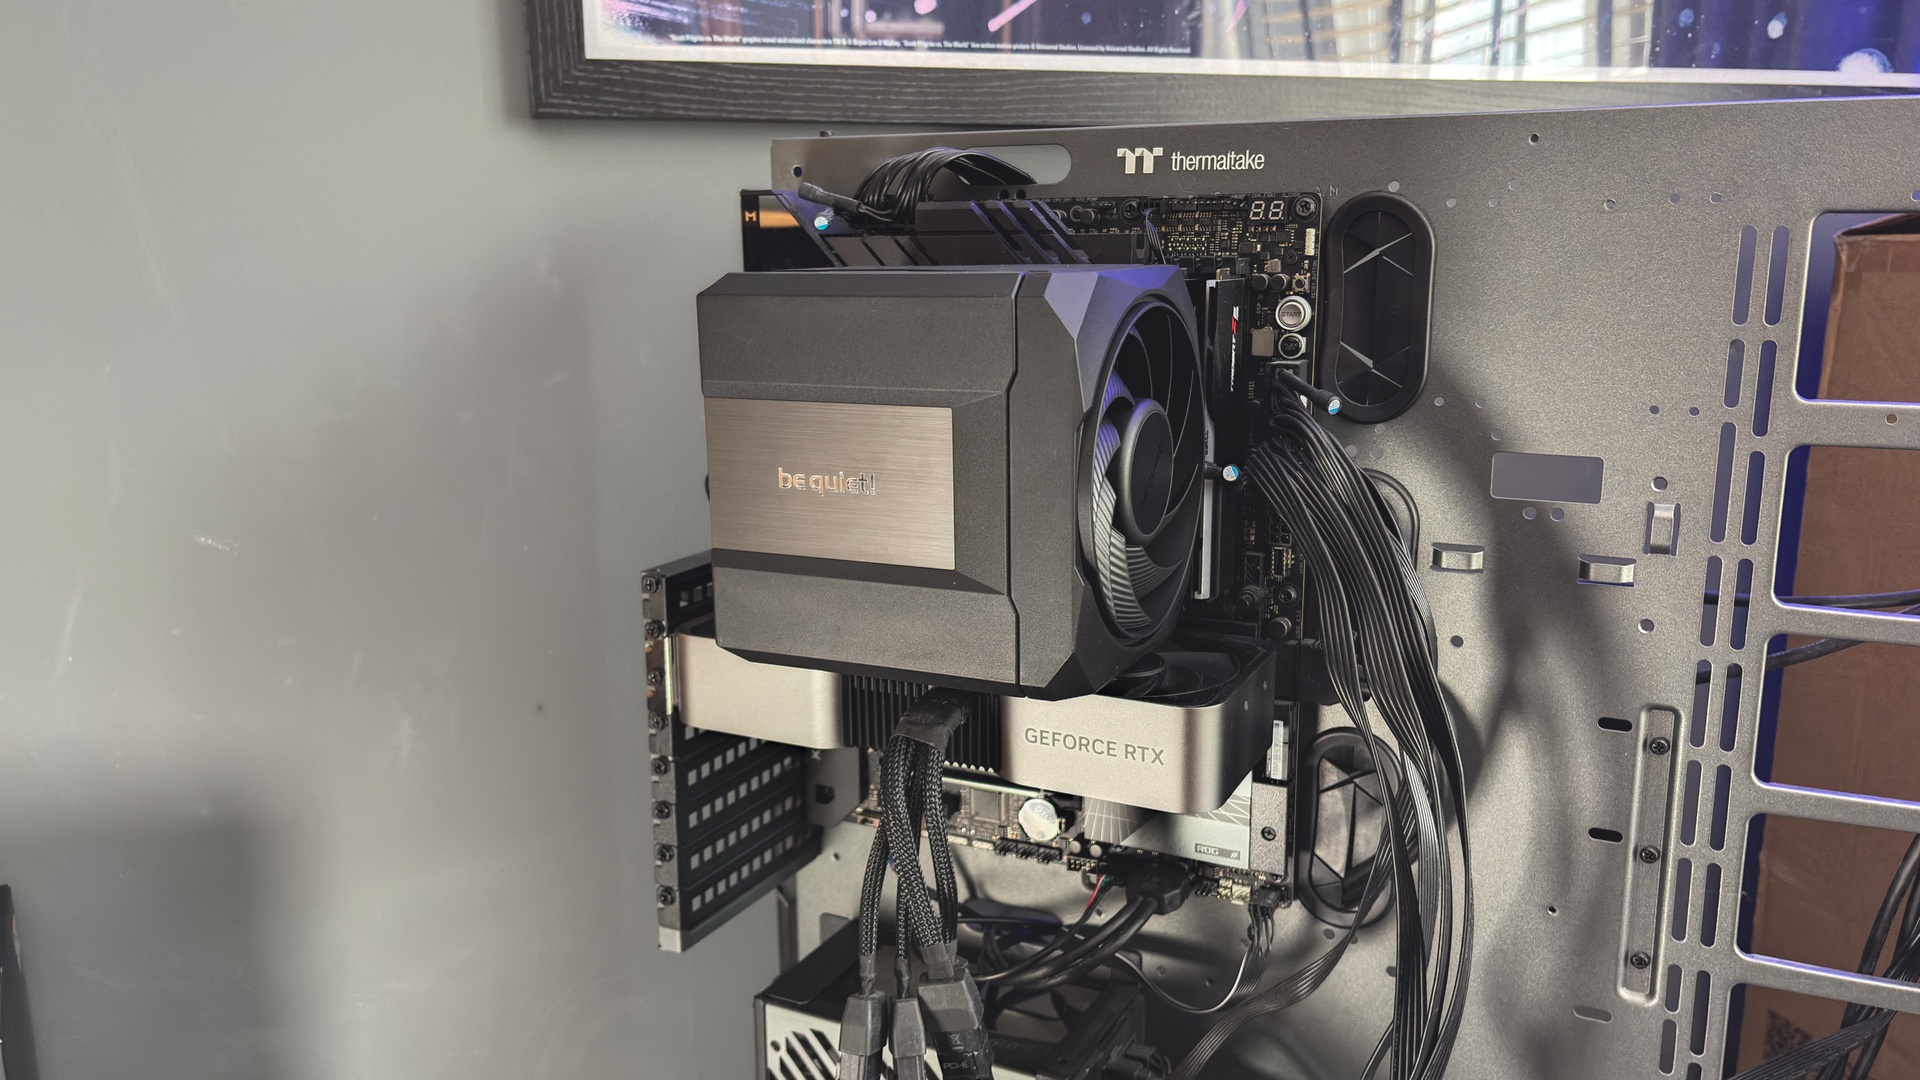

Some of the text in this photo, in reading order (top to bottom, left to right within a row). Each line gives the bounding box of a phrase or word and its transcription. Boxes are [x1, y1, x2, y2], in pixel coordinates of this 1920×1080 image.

[1171, 150, 1265, 171] thermaltake
[778, 468, 876, 496] be quiet!
[1025, 728, 1164, 765] GEFORCE RTX
[1197, 845, 1219, 855] ROG
